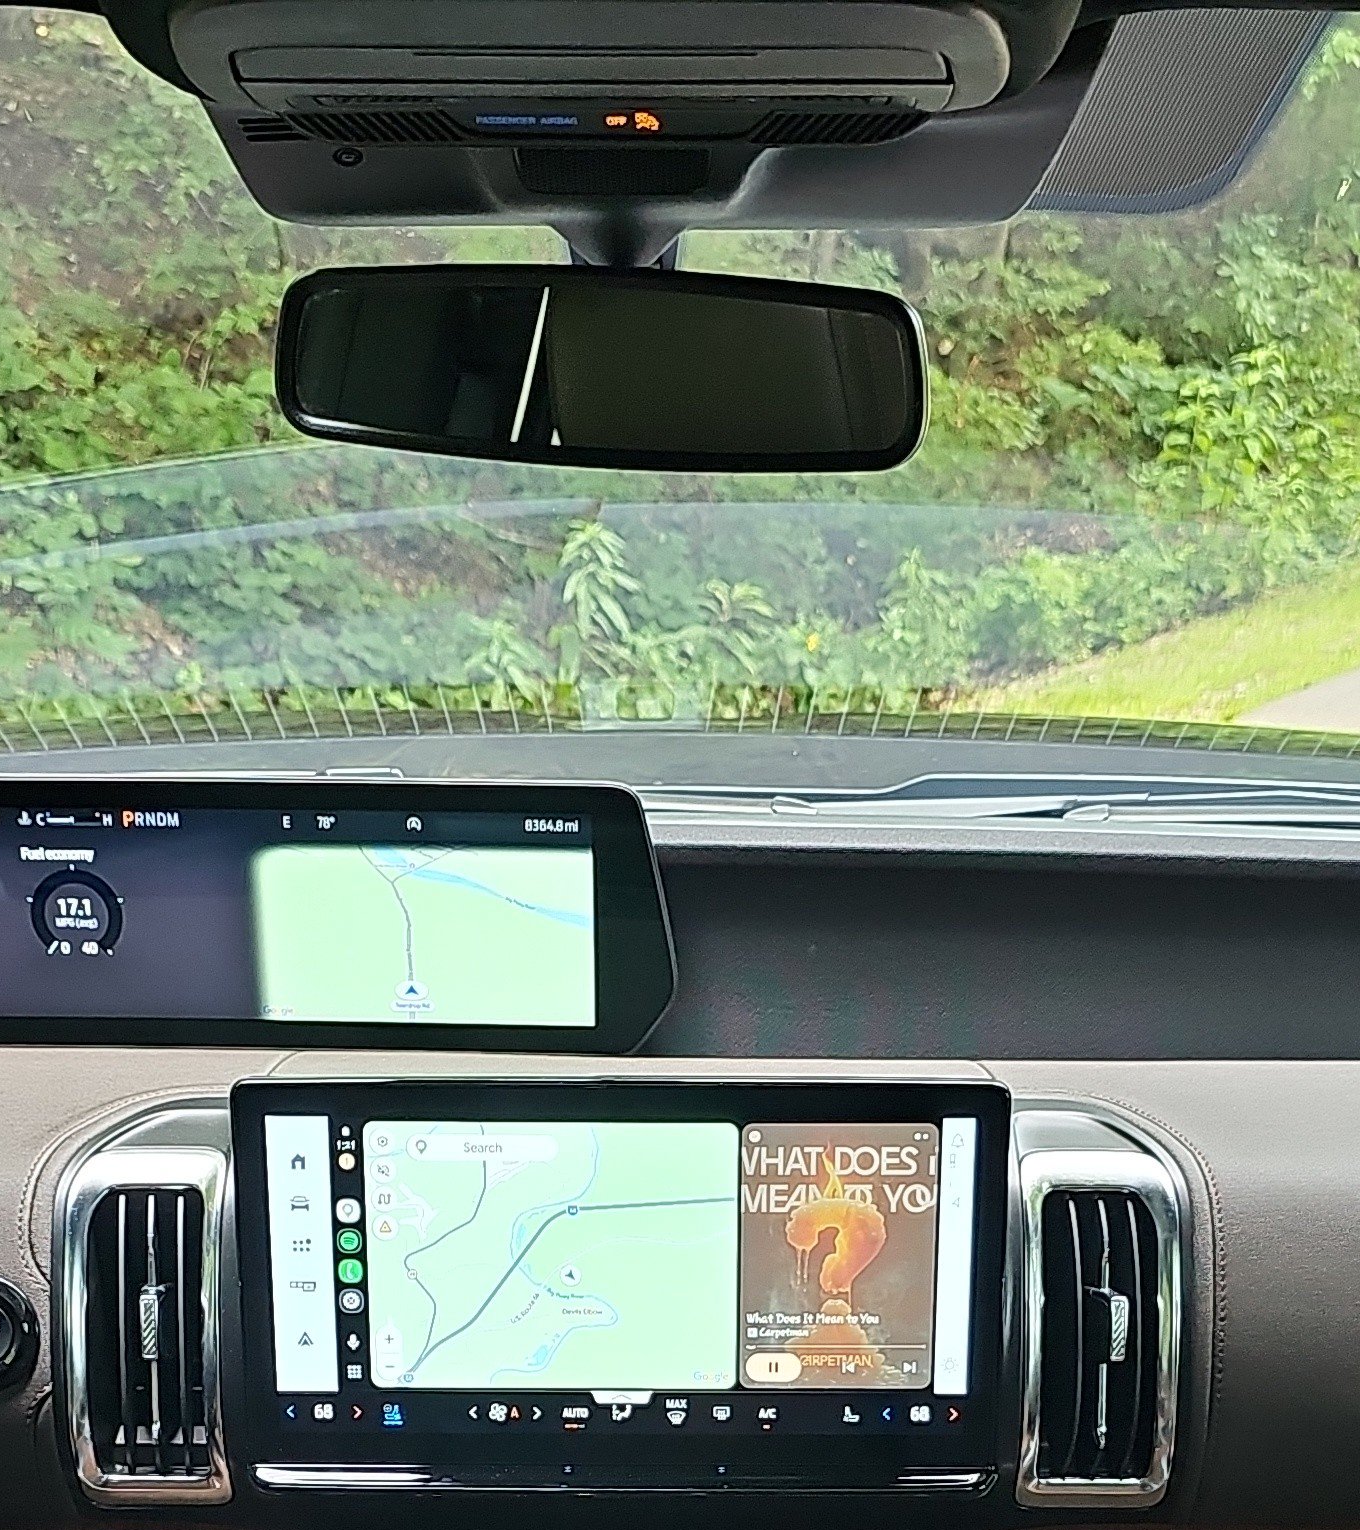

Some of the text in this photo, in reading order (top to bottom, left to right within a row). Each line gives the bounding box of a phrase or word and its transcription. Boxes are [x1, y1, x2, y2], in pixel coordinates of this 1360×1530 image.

[475, 115, 578, 125] PASSENGER AIRBAG
[606, 115, 627, 126] OFF
[281, 815, 291, 829] E
[19, 847, 95, 862] Fuel economy
[56, 898, 92, 916] 17.1
[463, 1142, 504, 1154] Search
[834, 1146, 919, 1176] DOES
[746, 1313, 880, 1324] What Does It Mean to You
[758, 1328, 810, 1339] Carpetman
[693, 1371, 729, 1382] Google
[665, 1398, 688, 1409] MAX
[510, 1406, 520, 1420] A
[562, 1406, 589, 1419] AUTO
[758, 1408, 777, 1419] A/C
[909, 1405, 931, 1422] 68
